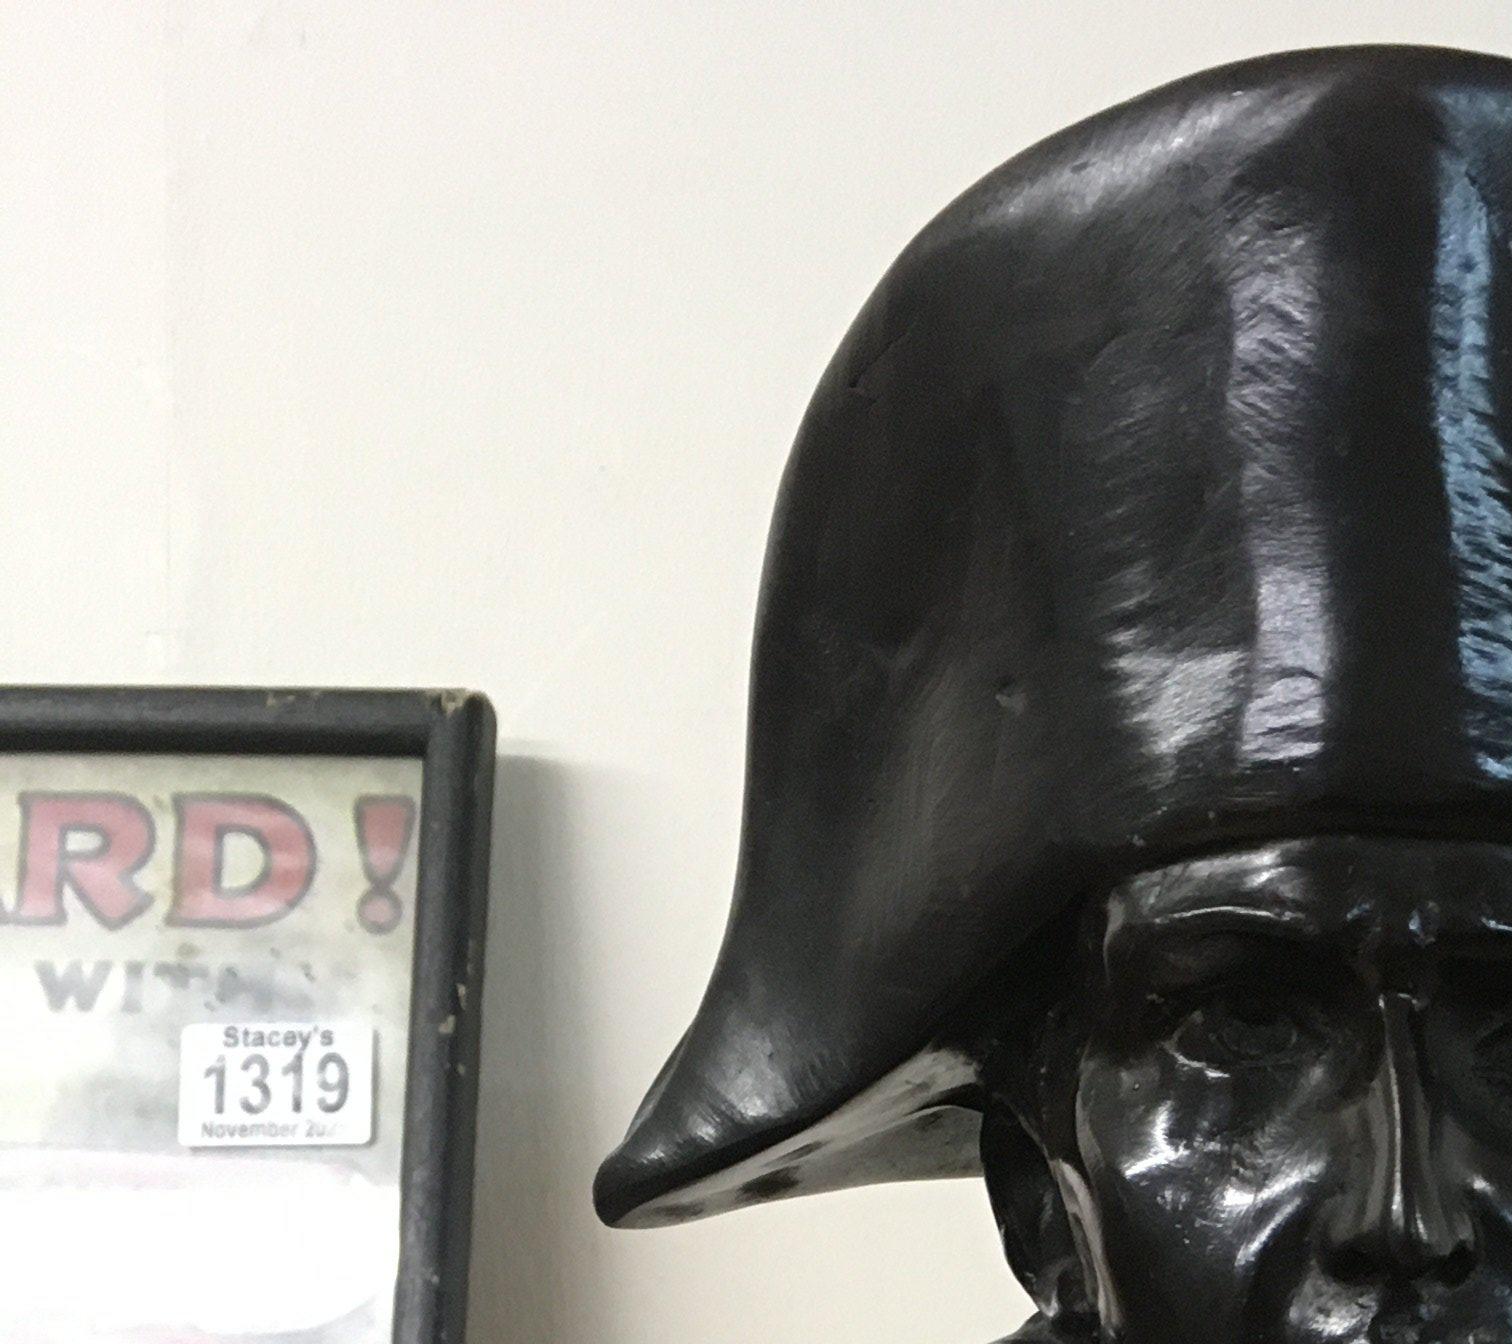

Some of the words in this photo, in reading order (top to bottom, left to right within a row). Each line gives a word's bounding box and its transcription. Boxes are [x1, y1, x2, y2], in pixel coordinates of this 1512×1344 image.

[0, 791, 417, 935] RD!
[223, 1025, 334, 1054] Stacey's
[203, 1052, 349, 1115] 1319
[201, 1121, 298, 1139] November
